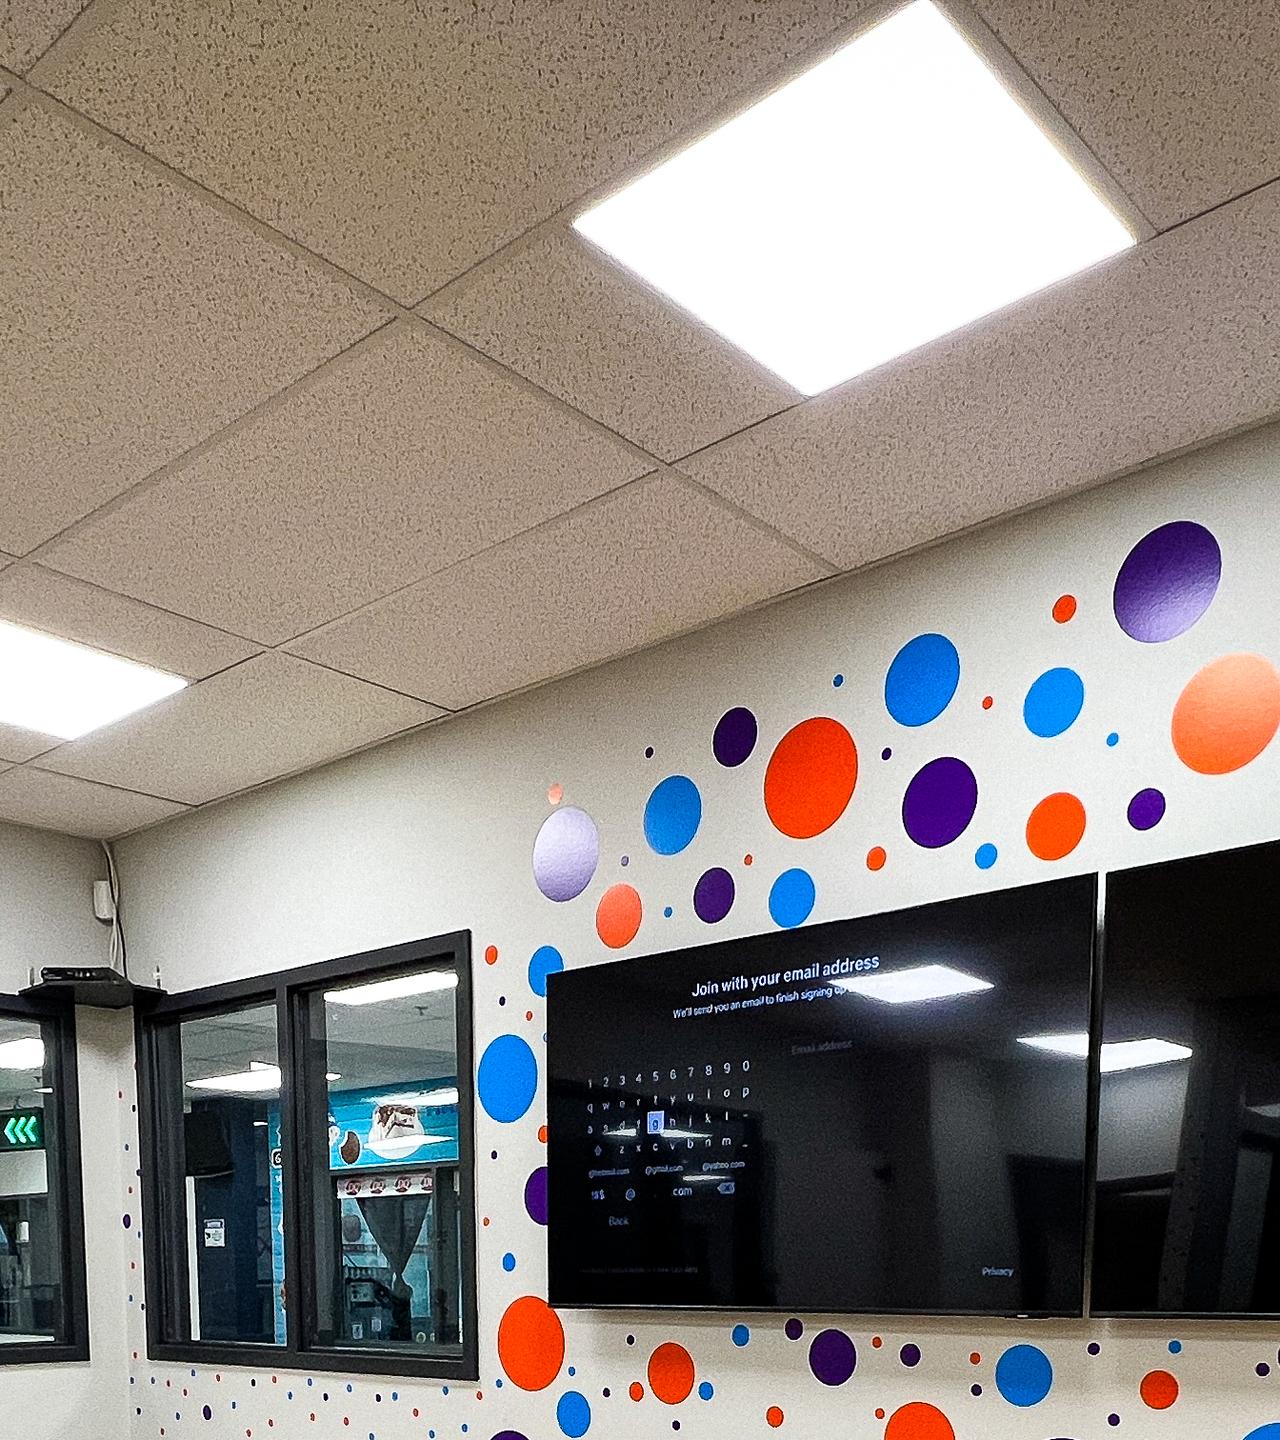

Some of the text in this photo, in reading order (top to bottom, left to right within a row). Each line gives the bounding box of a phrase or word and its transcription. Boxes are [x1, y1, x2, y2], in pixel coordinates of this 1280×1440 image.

[692, 955, 880, 997] Join with your email address
[714, 1002, 729, 1015] you
[730, 1000, 741, 1010] an
[742, 996, 765, 1009] email
[765, 995, 775, 1005] to
[775, 991, 799, 1004] finish
[800, 987, 833, 1002] signing
[981, 1266, 1014, 1277] Privacy
